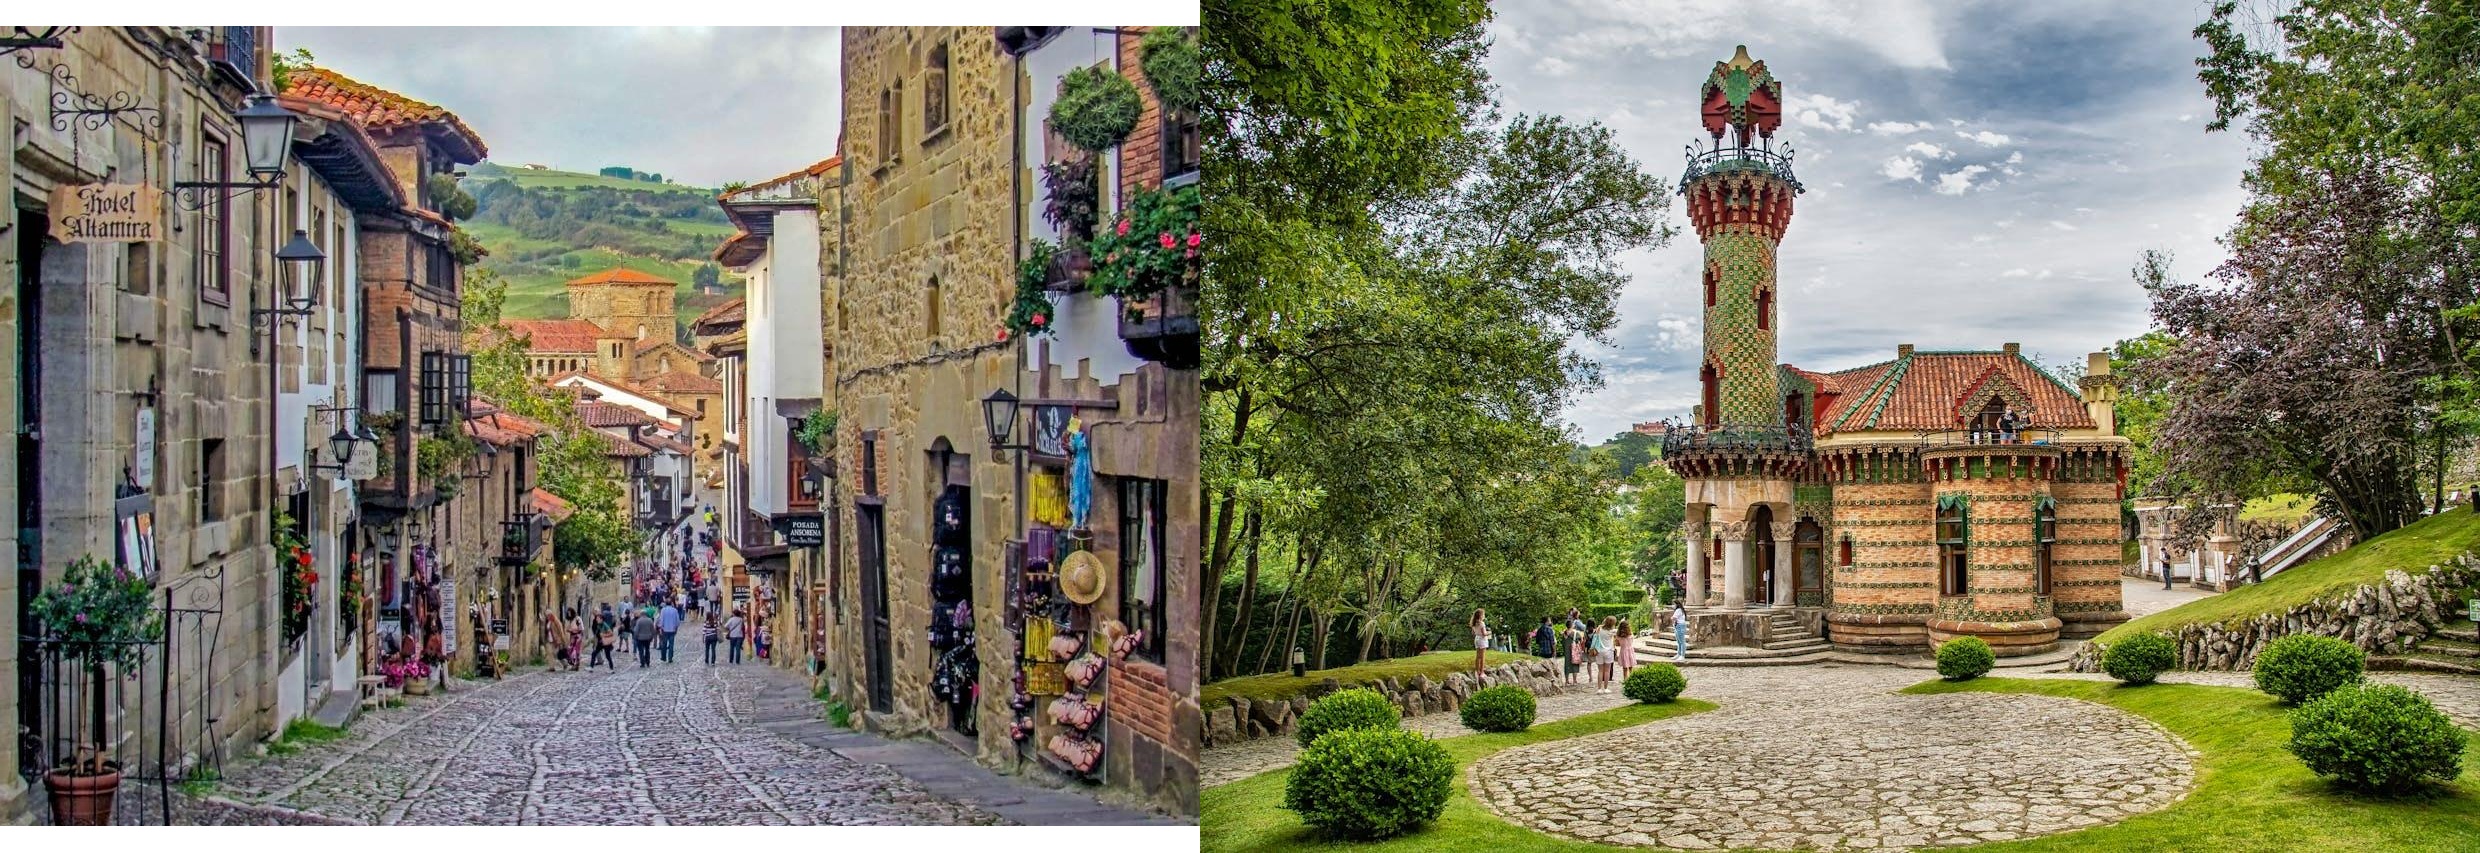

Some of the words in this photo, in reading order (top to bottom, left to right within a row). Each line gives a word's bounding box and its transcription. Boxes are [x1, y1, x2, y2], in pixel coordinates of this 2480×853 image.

[77, 187, 136, 214] Hotel
[61, 213, 151, 238] Altamira
[790, 529, 822, 537] ANSORENA
[792, 521, 819, 529] POSADA
